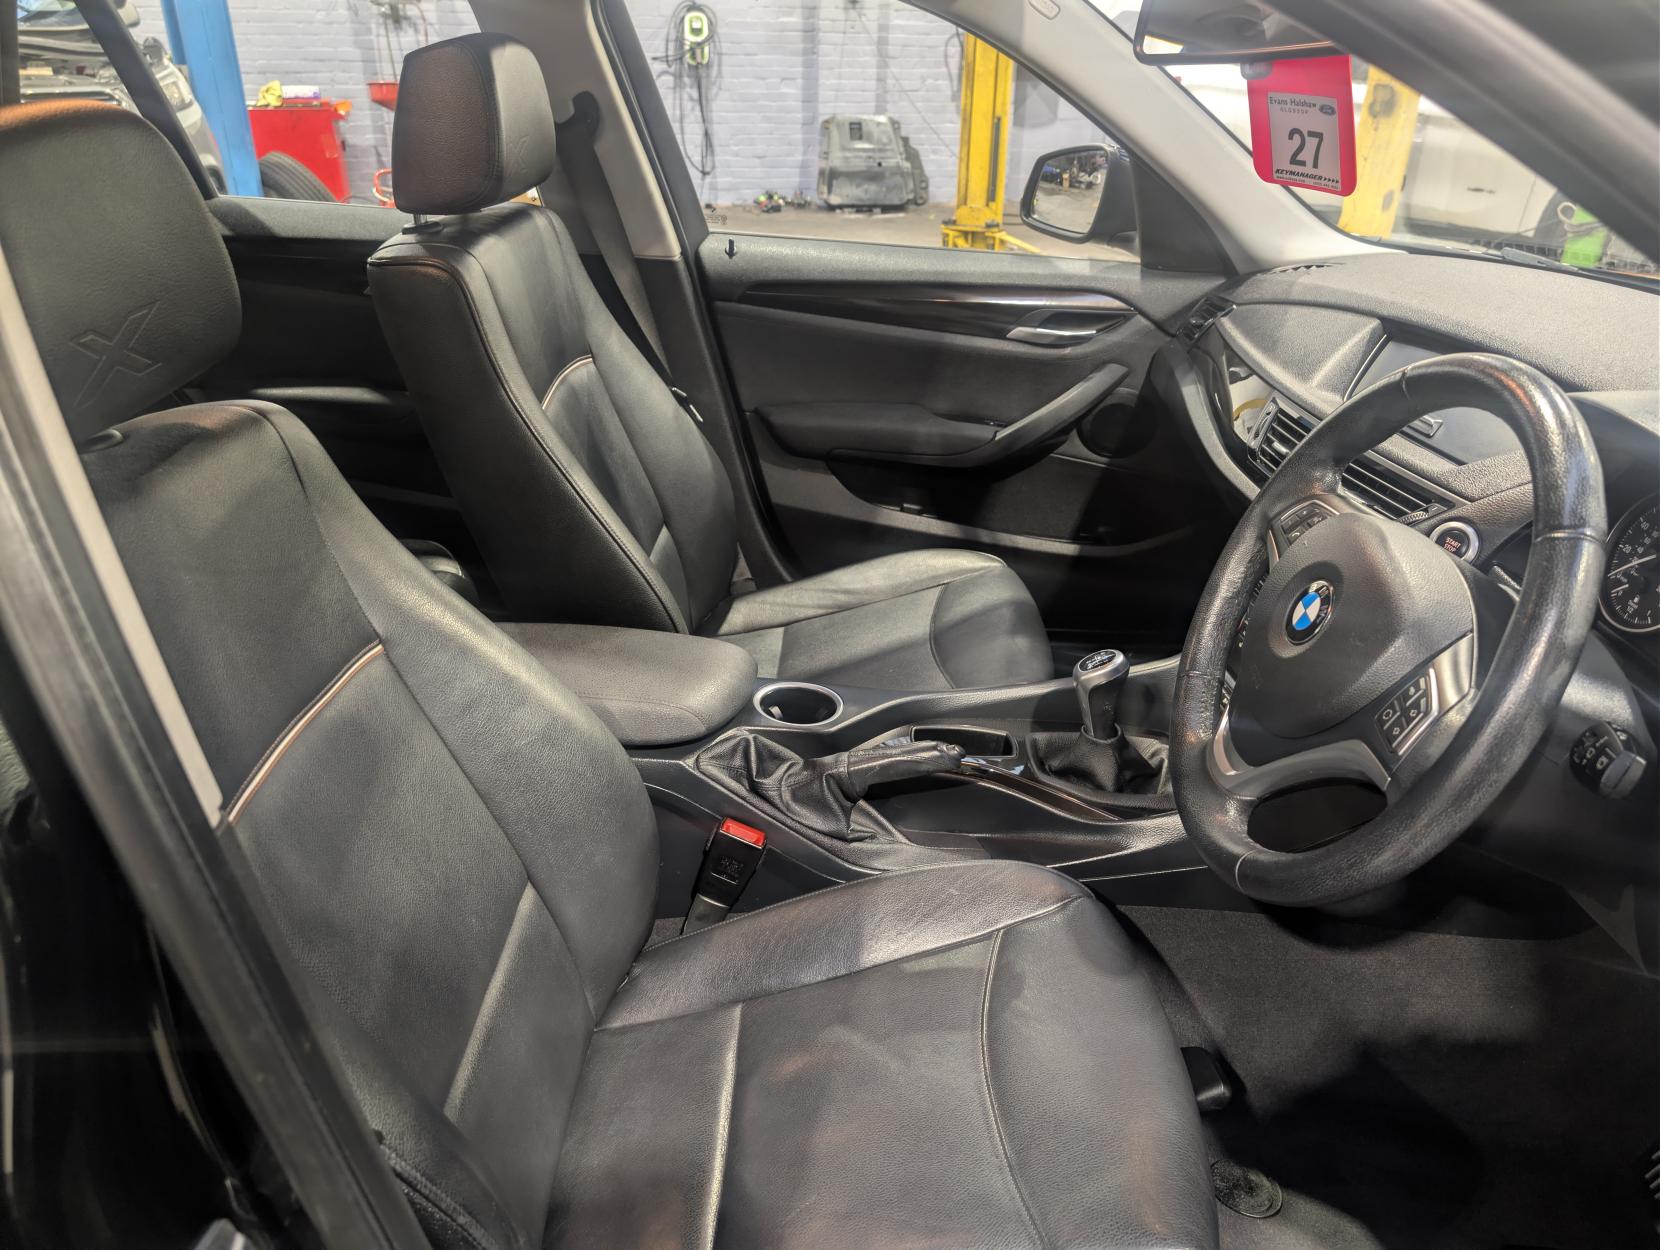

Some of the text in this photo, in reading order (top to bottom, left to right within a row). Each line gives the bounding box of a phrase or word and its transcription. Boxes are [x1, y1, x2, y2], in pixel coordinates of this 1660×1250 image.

[1269, 96, 1317, 108] Evans Halshaw
[1287, 127, 1324, 169] 27
[1275, 168, 1323, 181] KEYMANAGER
[1444, 543, 1457, 552] STOP
[1445, 536, 1461, 548] START
